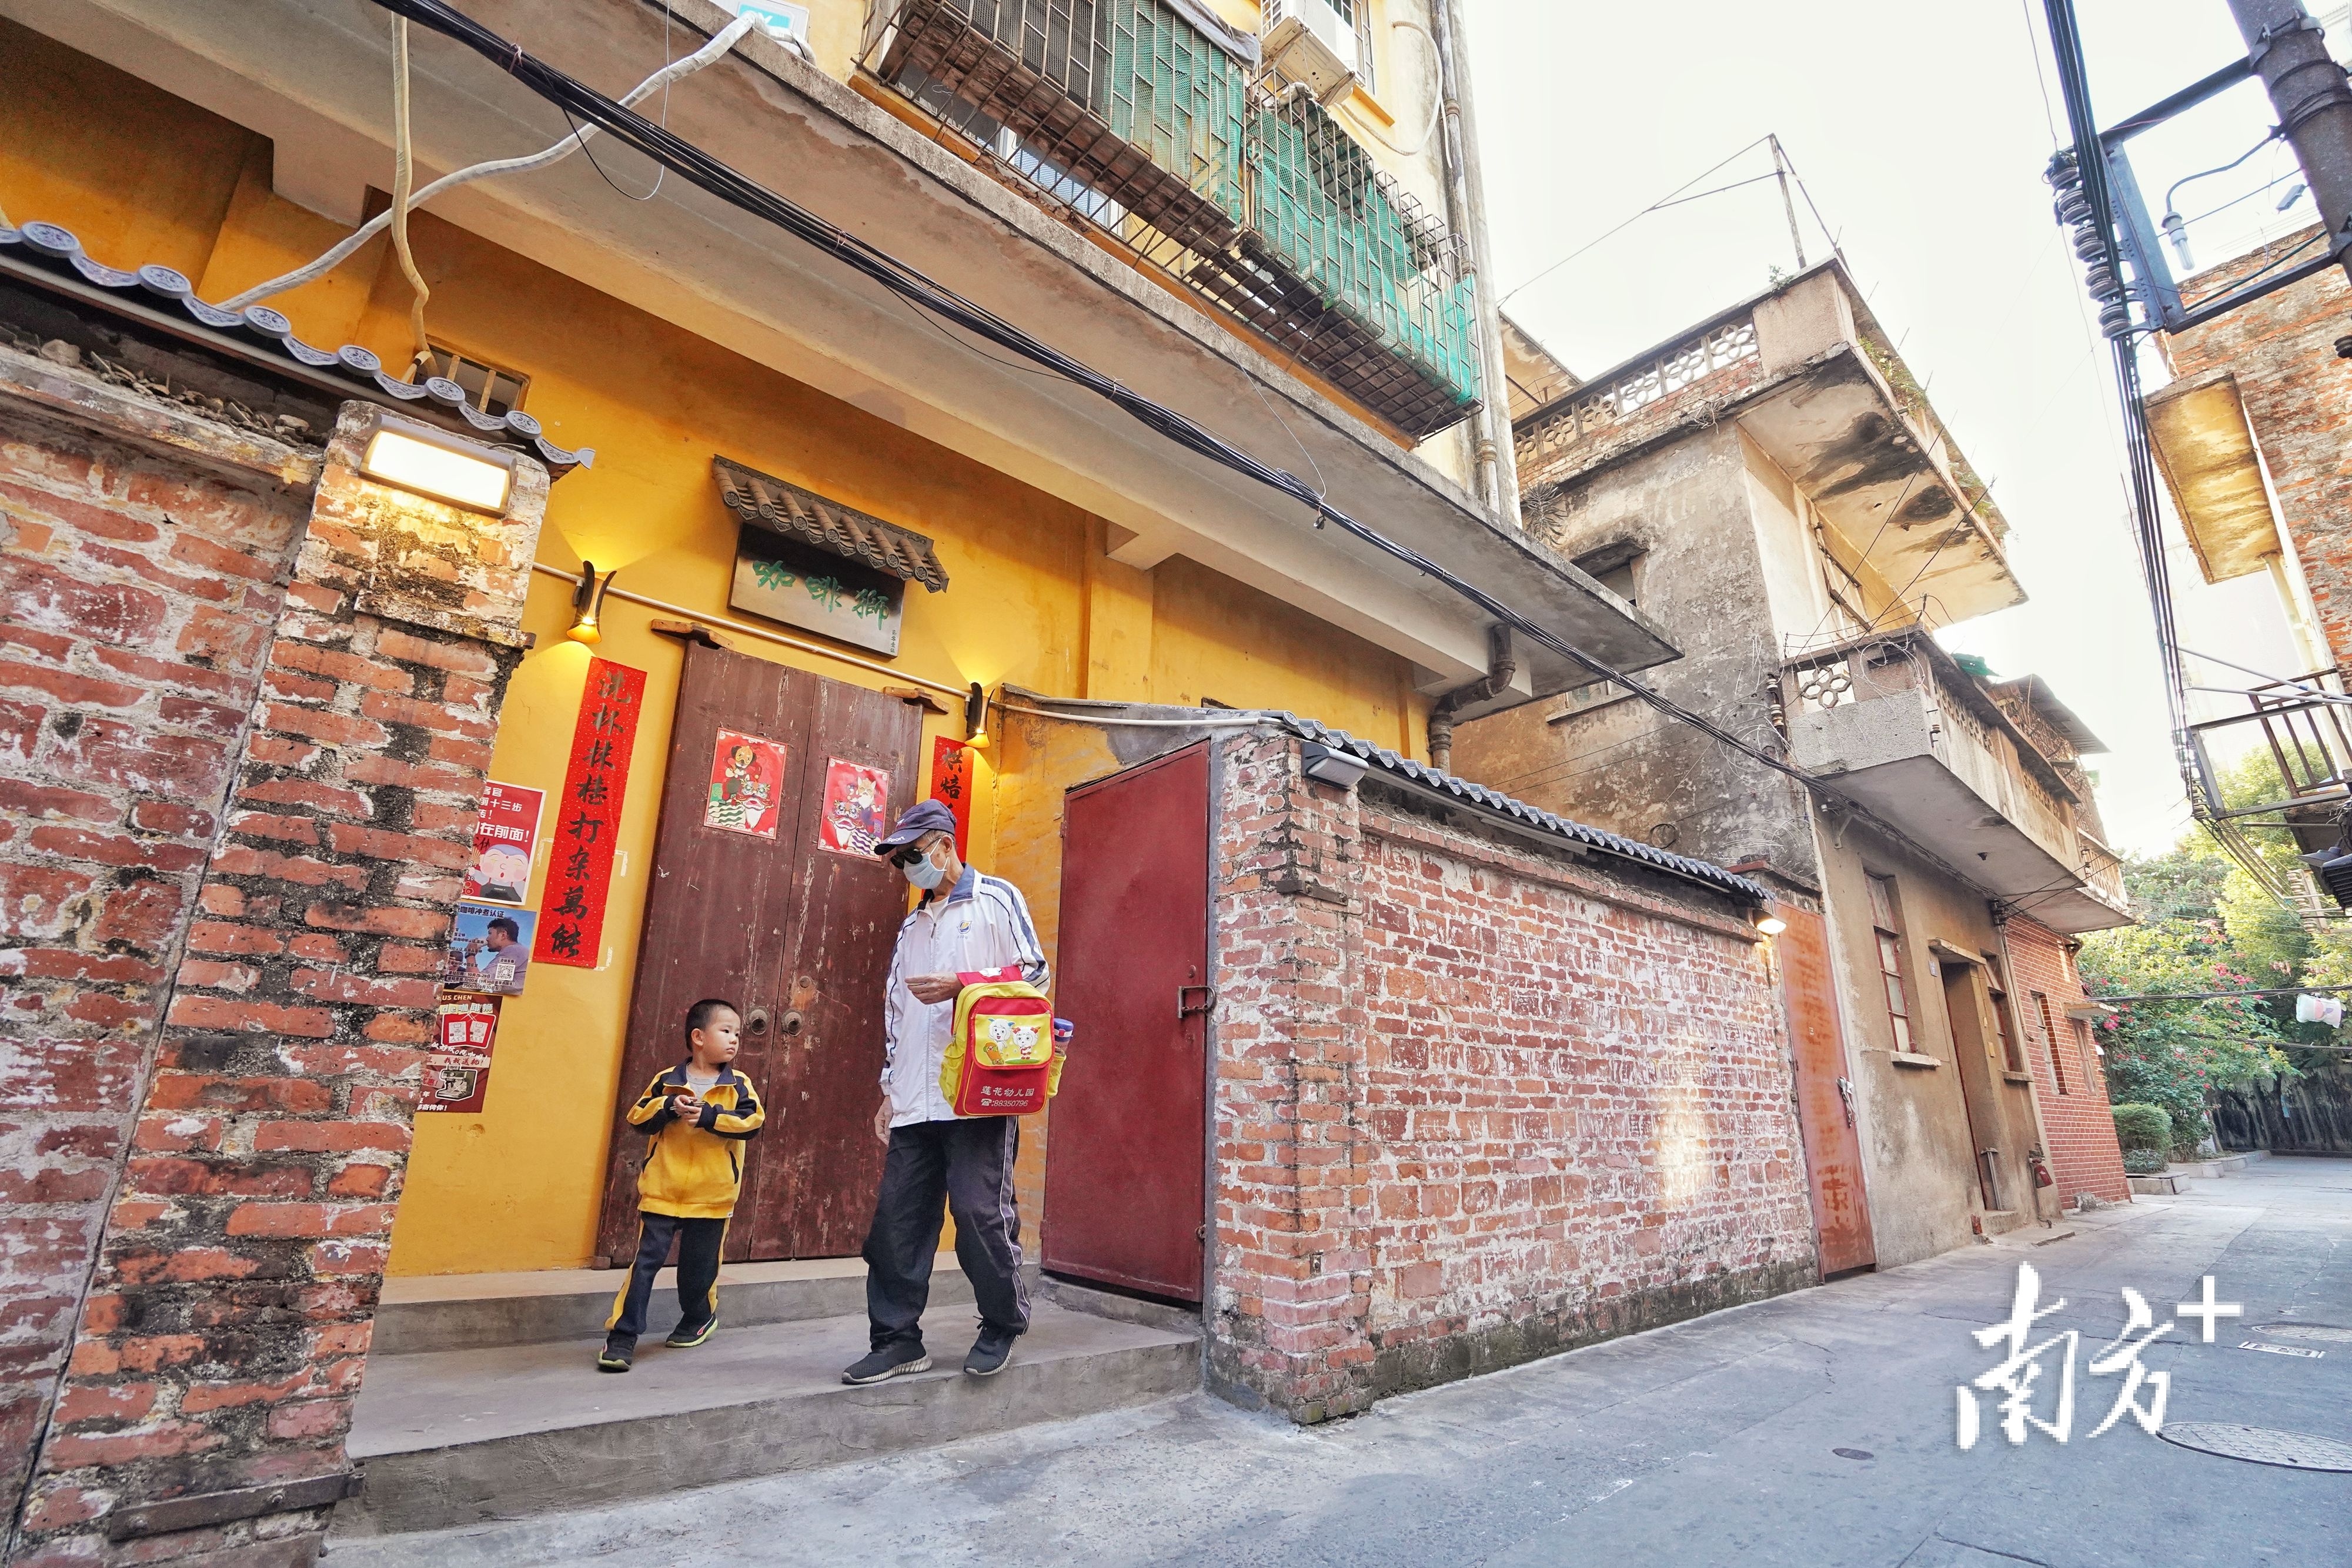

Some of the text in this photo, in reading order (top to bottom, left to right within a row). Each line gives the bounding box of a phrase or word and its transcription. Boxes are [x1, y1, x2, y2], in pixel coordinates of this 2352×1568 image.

[940, 747, 963, 810] 烘焙
[476, 821, 529, 842] 在前面！
[981, 1085, 1034, 1096] 莲花幼儿园
